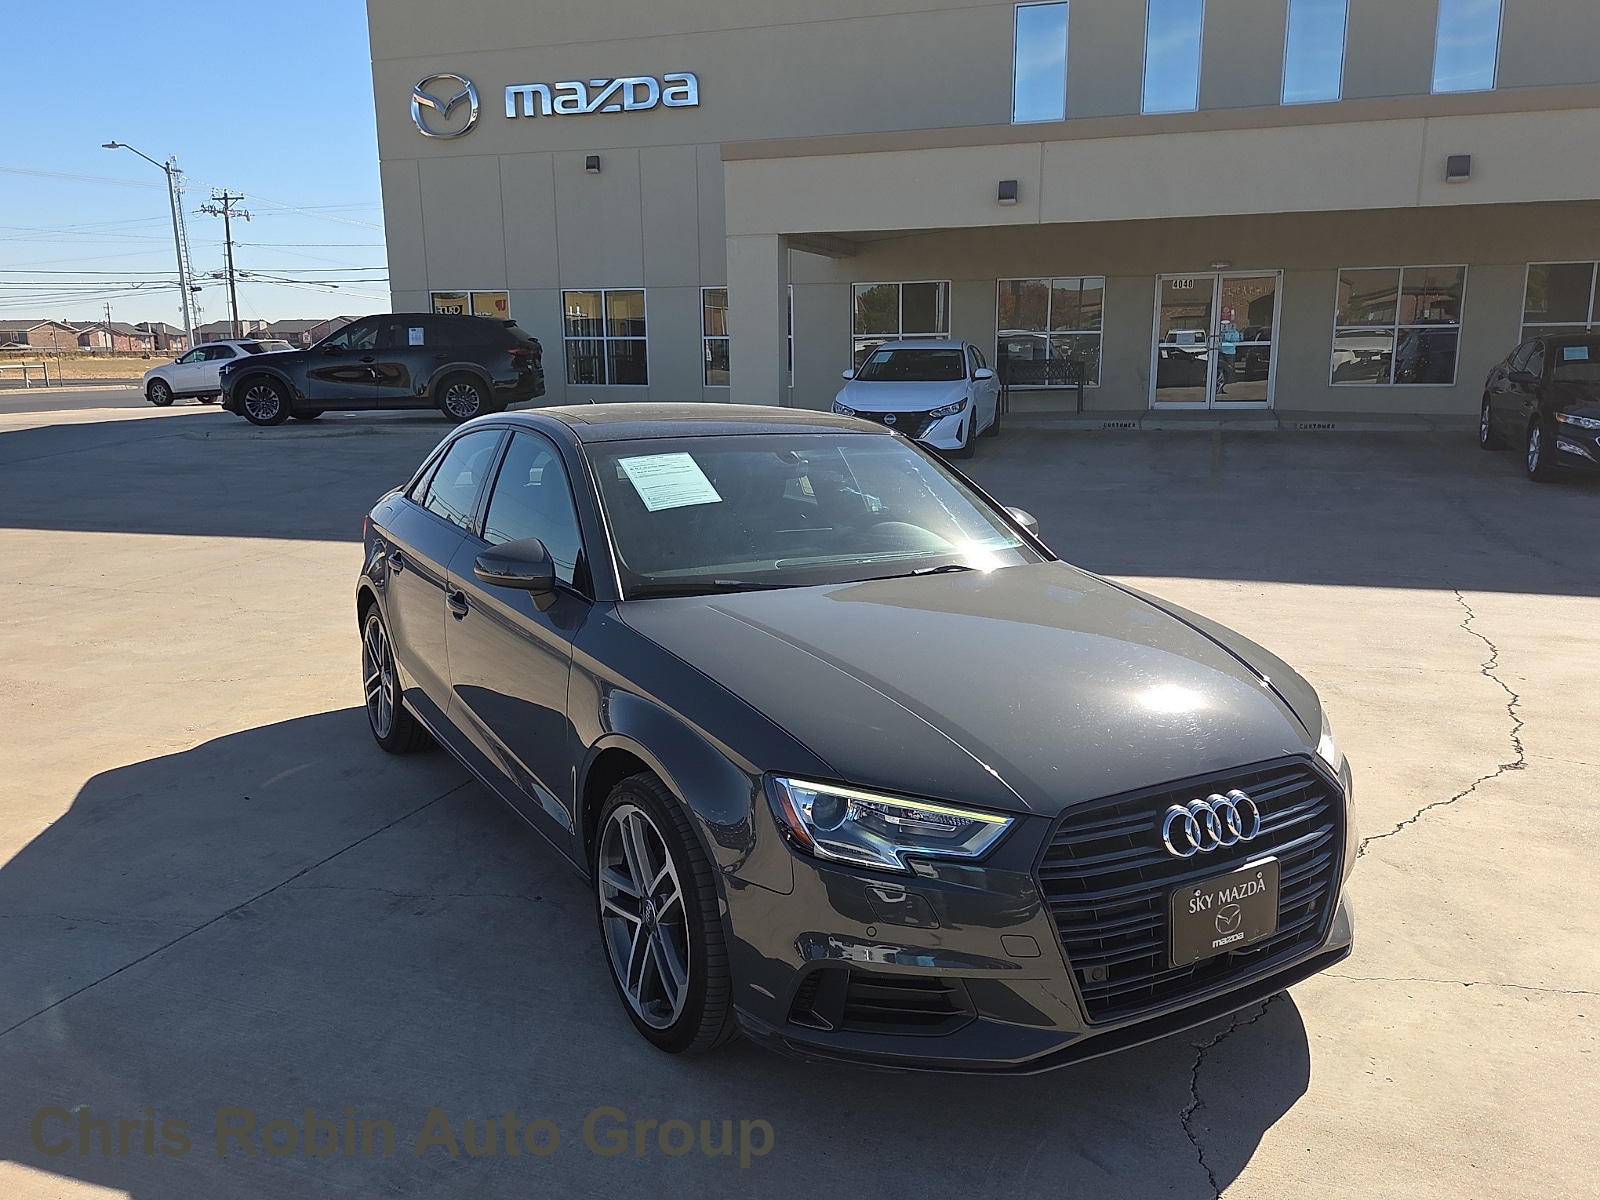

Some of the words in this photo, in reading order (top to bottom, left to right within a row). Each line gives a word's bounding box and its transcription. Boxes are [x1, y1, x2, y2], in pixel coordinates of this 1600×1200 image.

[1172, 279, 1194, 289] 4040
[1188, 893, 1214, 914] SKY
[1218, 878, 1266, 905] MAZDA
